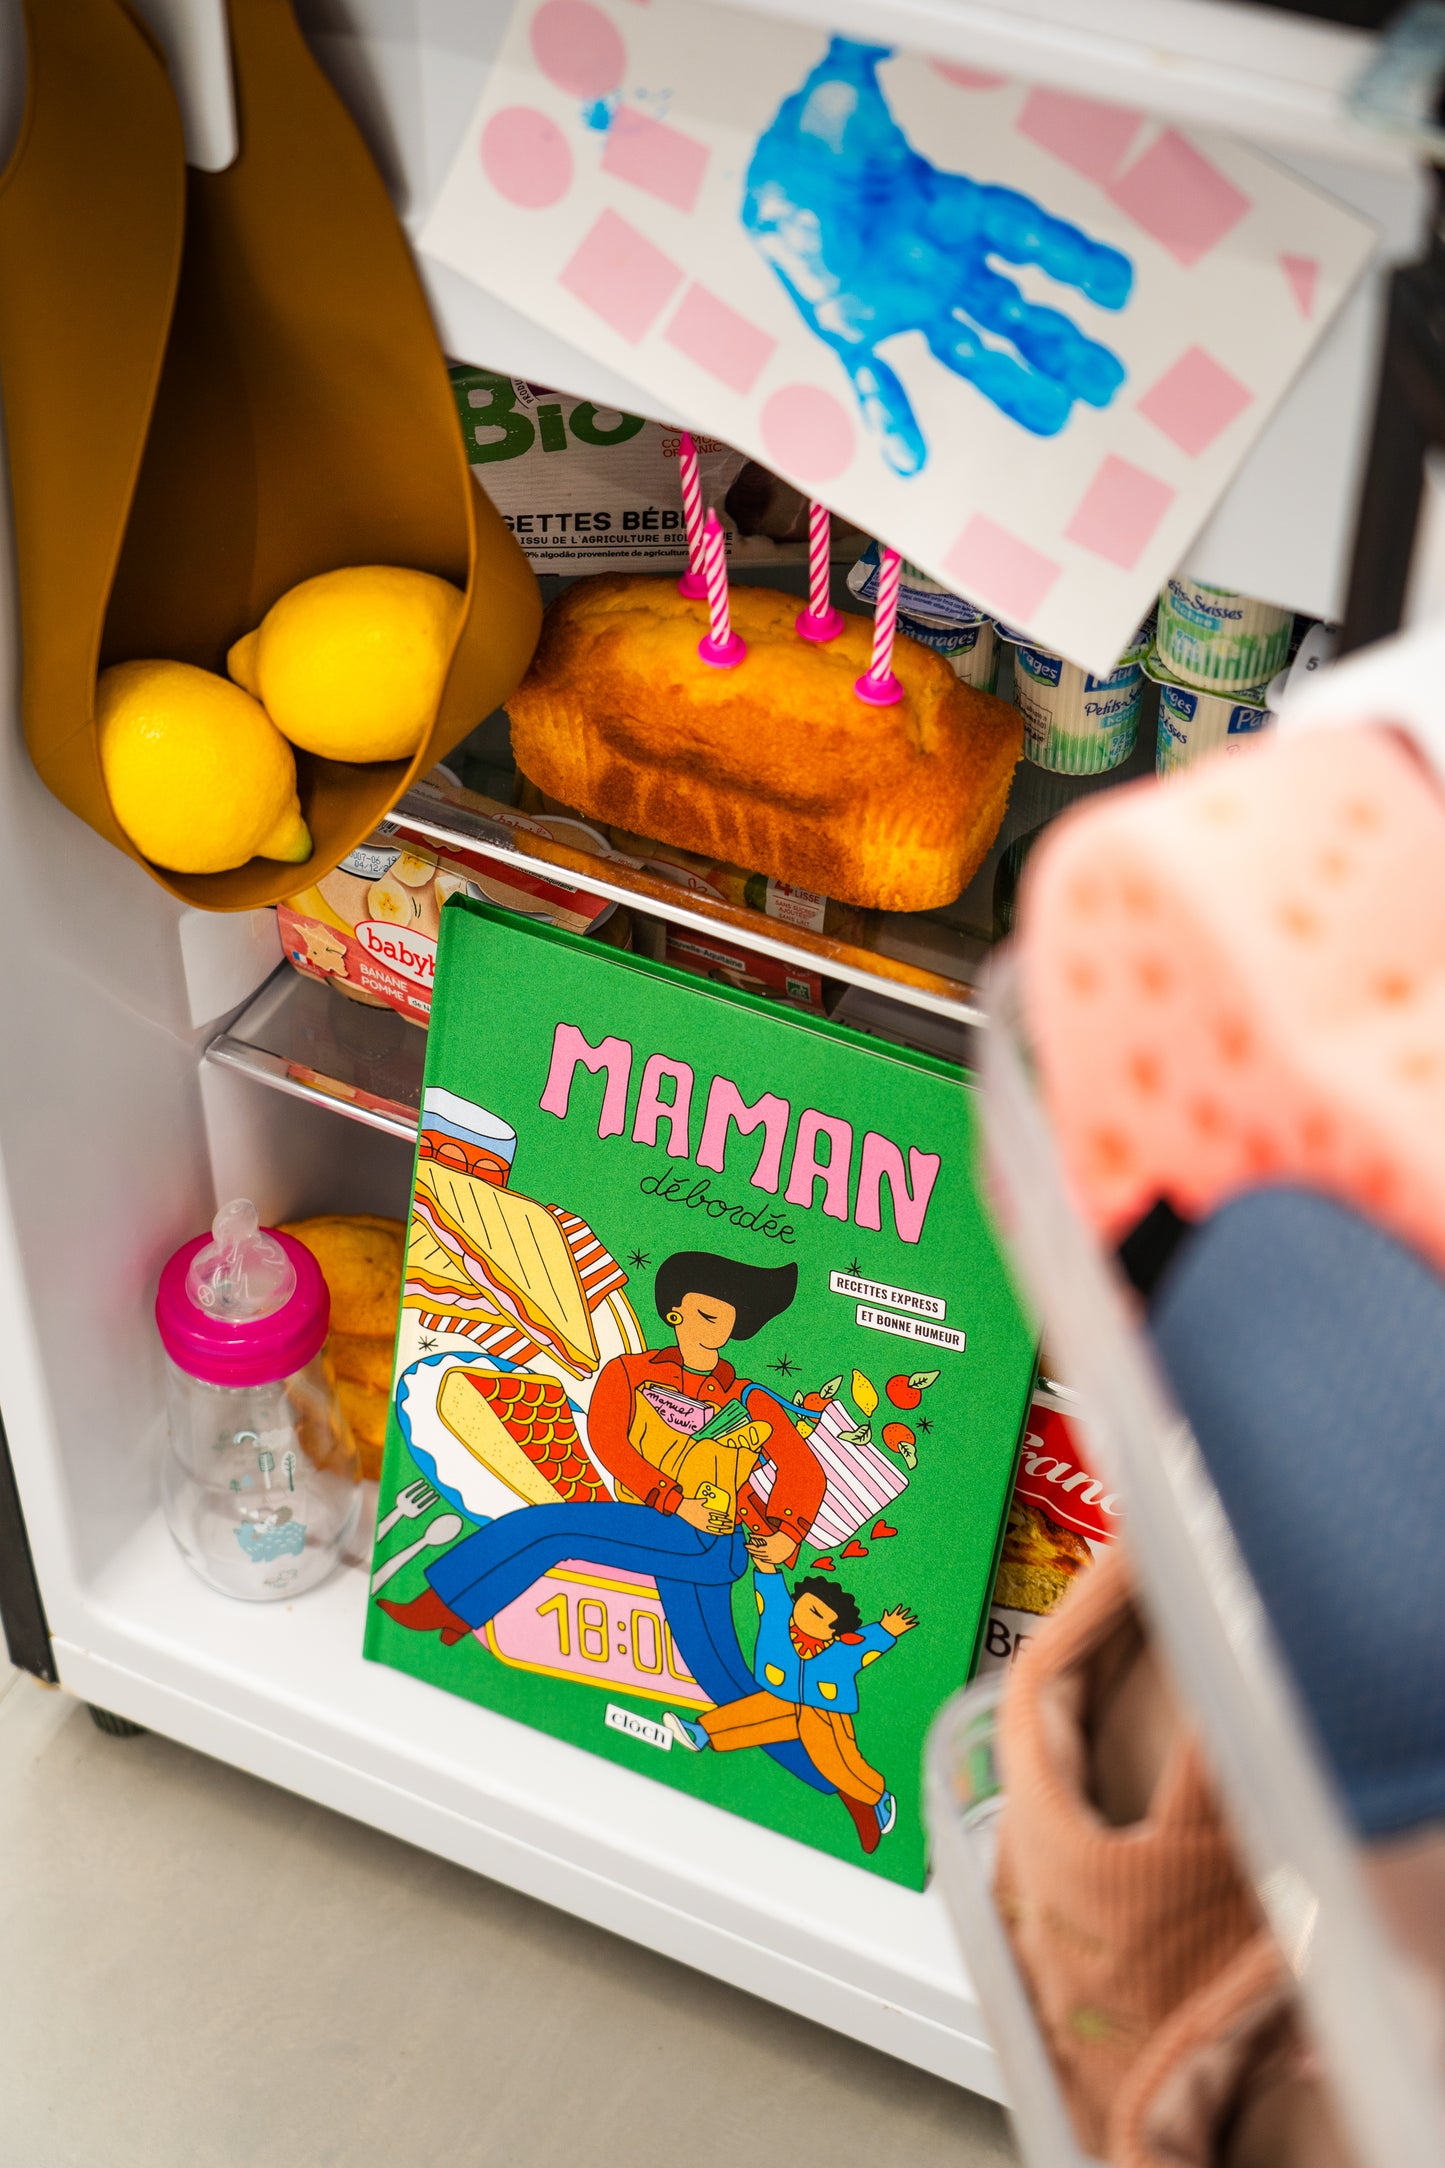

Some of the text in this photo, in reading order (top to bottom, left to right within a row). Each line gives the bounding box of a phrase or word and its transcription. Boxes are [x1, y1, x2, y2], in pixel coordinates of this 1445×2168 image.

[450, 364, 645, 465] Bio
[520, 536, 548, 545] ISSU
[552, 536, 567, 544] DE
[571, 534, 660, 544] L'AGRICULTURE
[577, 549, 630, 559] proveniente
[630, 549, 643, 557] de
[794, 890, 820, 905] LISSE
[359, 963, 408, 993] BANANE
[361, 976, 406, 1002] POMME
[538, 1021, 942, 1245] MAMAN
[639, 1166, 797, 1245] débordée
[836, 1277, 939, 1314] RECETTES EXPRESS
[861, 1310, 961, 1346] ET BONNE HUMEUR
[646, 1391, 695, 1417] manuel
